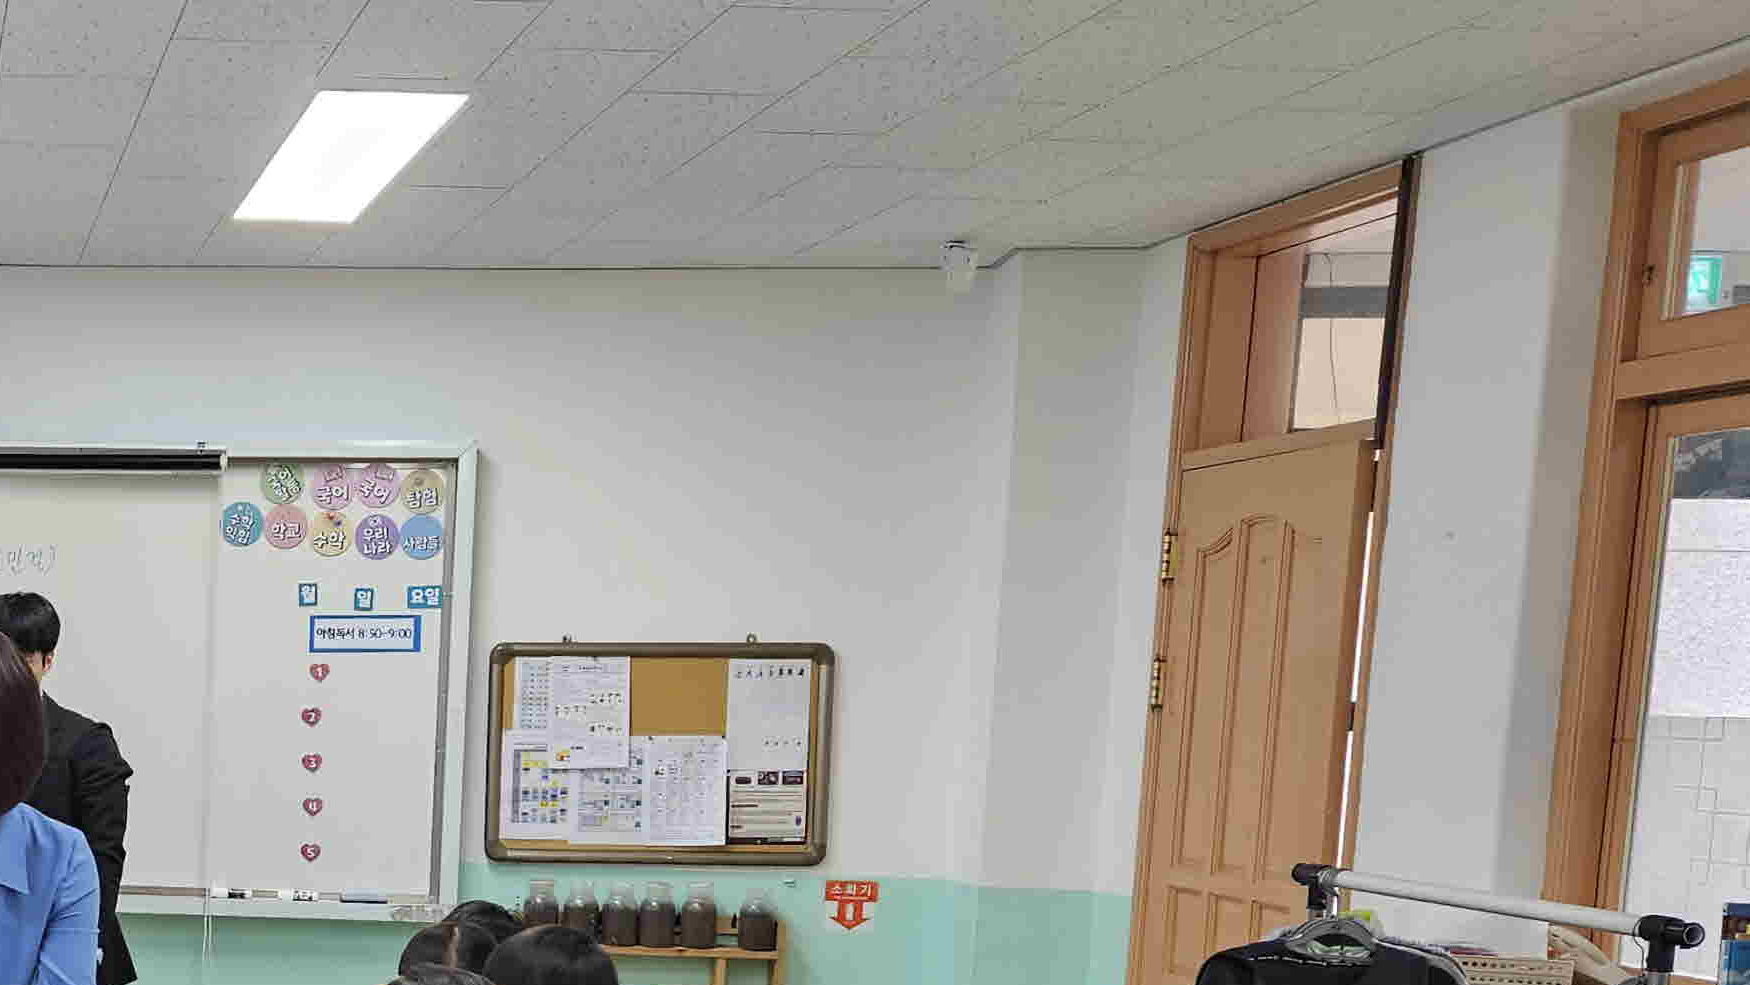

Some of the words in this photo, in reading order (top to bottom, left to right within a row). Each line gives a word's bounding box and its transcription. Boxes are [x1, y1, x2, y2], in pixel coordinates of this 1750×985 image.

[316, 482, 351, 504] 국어
[229, 512, 255, 529] 수학
[272, 521, 303, 541] 학교
[313, 529, 347, 551] 수학
[361, 524, 389, 541] 우리
[362, 540, 392, 556] 나라
[402, 534, 443, 553] 사람들
[411, 587, 441, 606] 요일
[316, 626, 355, 641] 아침독서
[828, 882, 873, 898] 소화기
